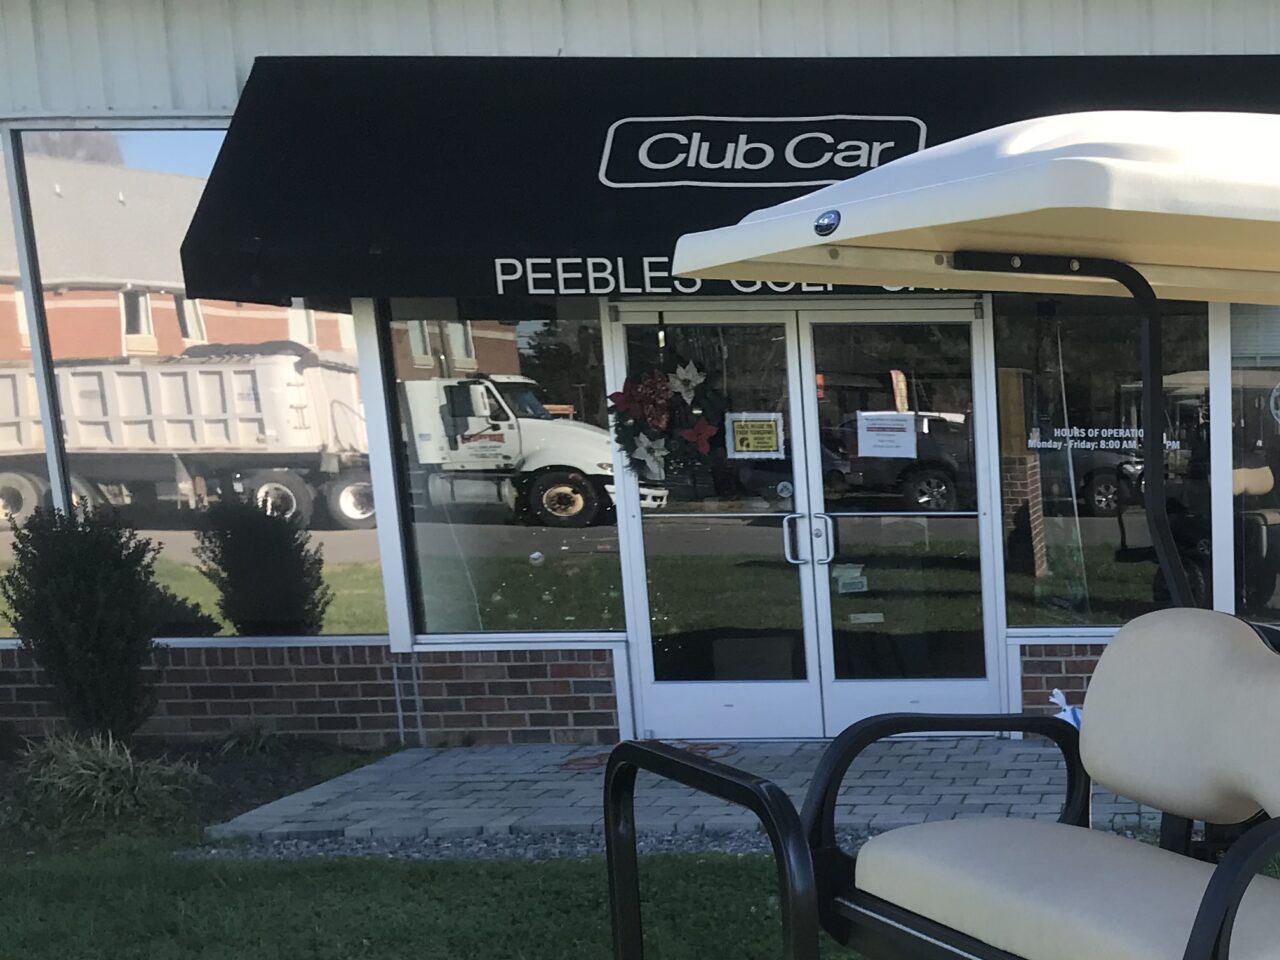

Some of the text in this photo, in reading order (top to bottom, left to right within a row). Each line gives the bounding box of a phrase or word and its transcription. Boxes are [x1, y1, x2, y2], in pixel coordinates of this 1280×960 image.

[638, 132, 895, 170] Club Car
[1054, 428, 1144, 438] HOURS OF OPERATIO
[1028, 440, 1062, 450] Monday
[1069, 440, 1098, 450] Friday:
[1100, 440, 1120, 449] 8:00
[1122, 440, 1137, 449] AM
[1166, 440, 1180, 450] PM
